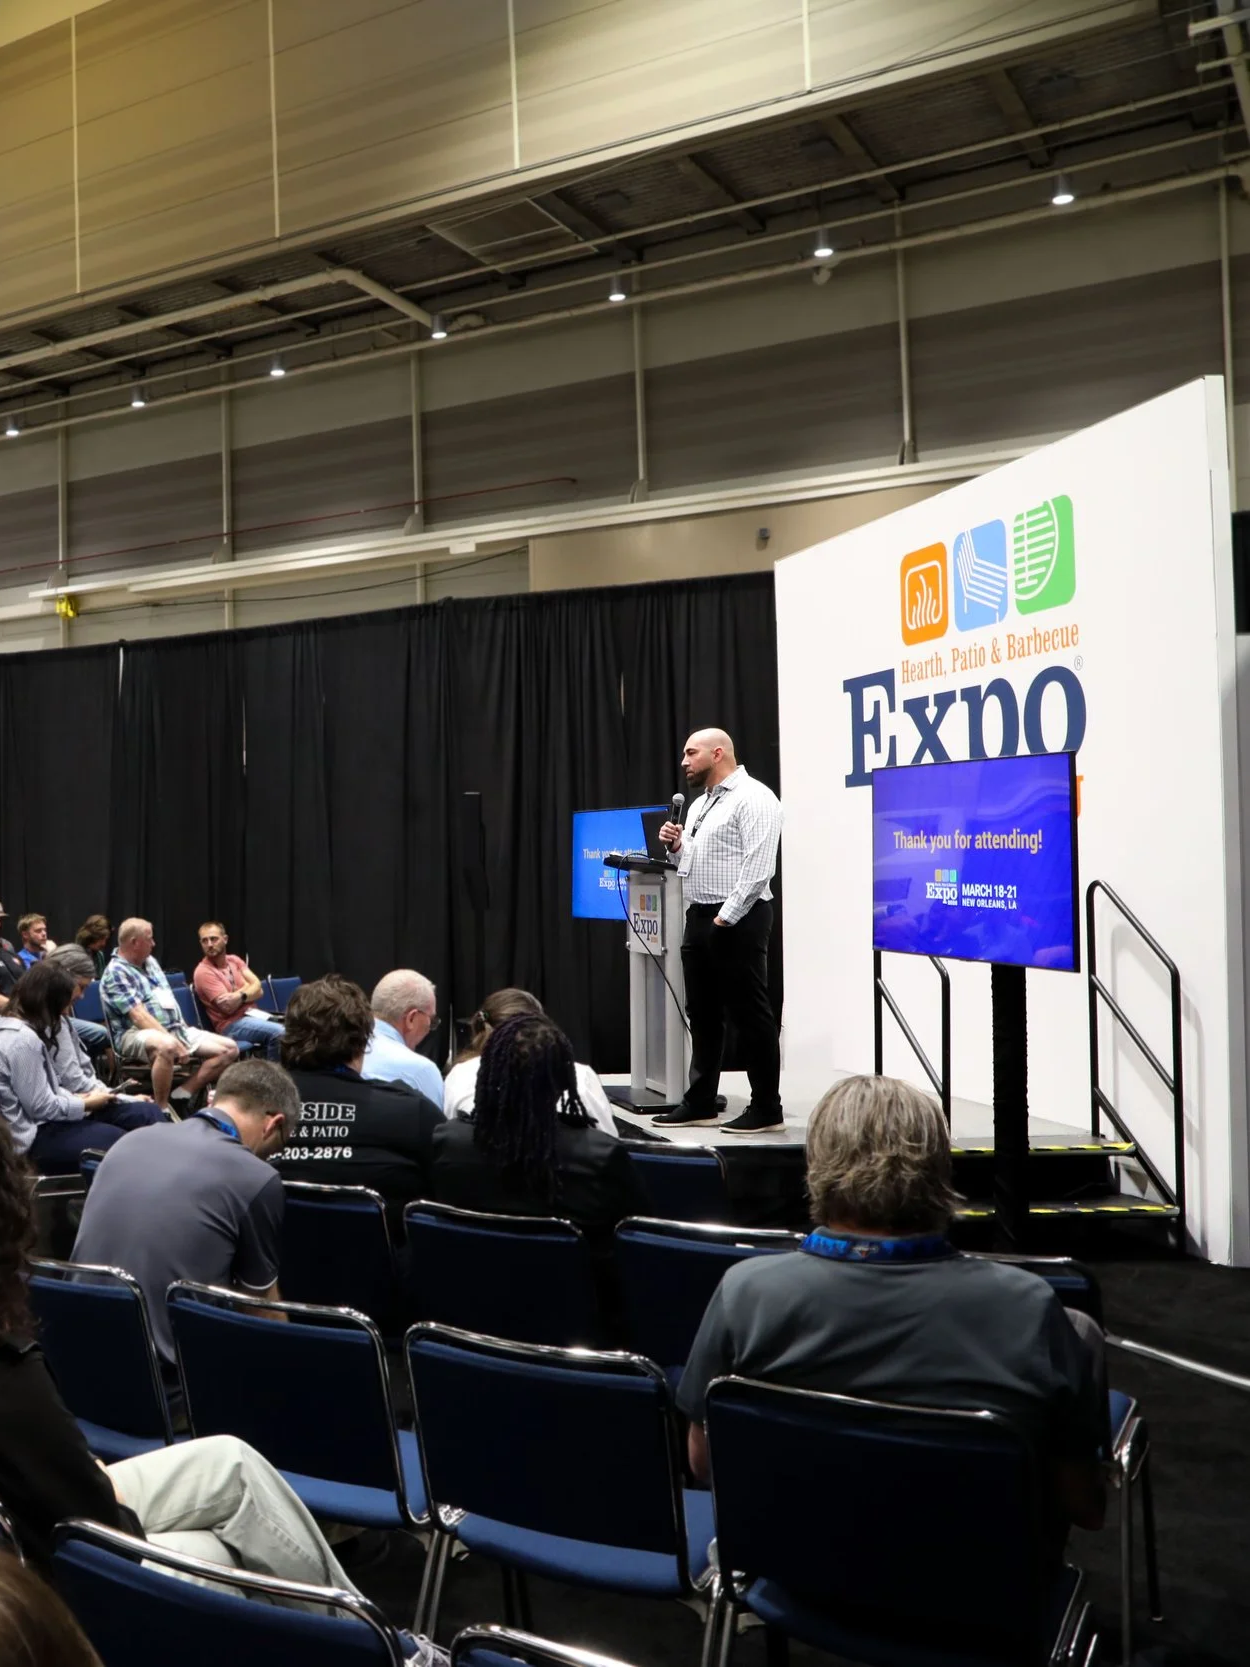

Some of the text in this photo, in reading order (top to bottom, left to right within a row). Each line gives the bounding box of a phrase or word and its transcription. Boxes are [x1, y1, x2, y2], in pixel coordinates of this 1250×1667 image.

[902, 623, 1080, 684] Hearth, Patio & Barbecue
[843, 665, 1087, 788] Expo
[893, 828, 1043, 855] Thank you for attending!
[583, 848, 601, 859] Thank
[599, 877, 615, 889] Expo
[962, 883, 992, 897] MARCH
[994, 885, 1017, 898] 18-21
[926, 882, 958, 904] Expo
[962, 898, 975, 907] NEW
[976, 899, 1007, 910] ORLEANS,
[1008, 900, 1017, 909] LA
[633, 912, 658, 940] Expo
[299, 1126, 309, 1138] &
[312, 1126, 349, 1138] PATIO
[269, 1147, 353, 1160] -203-2876
